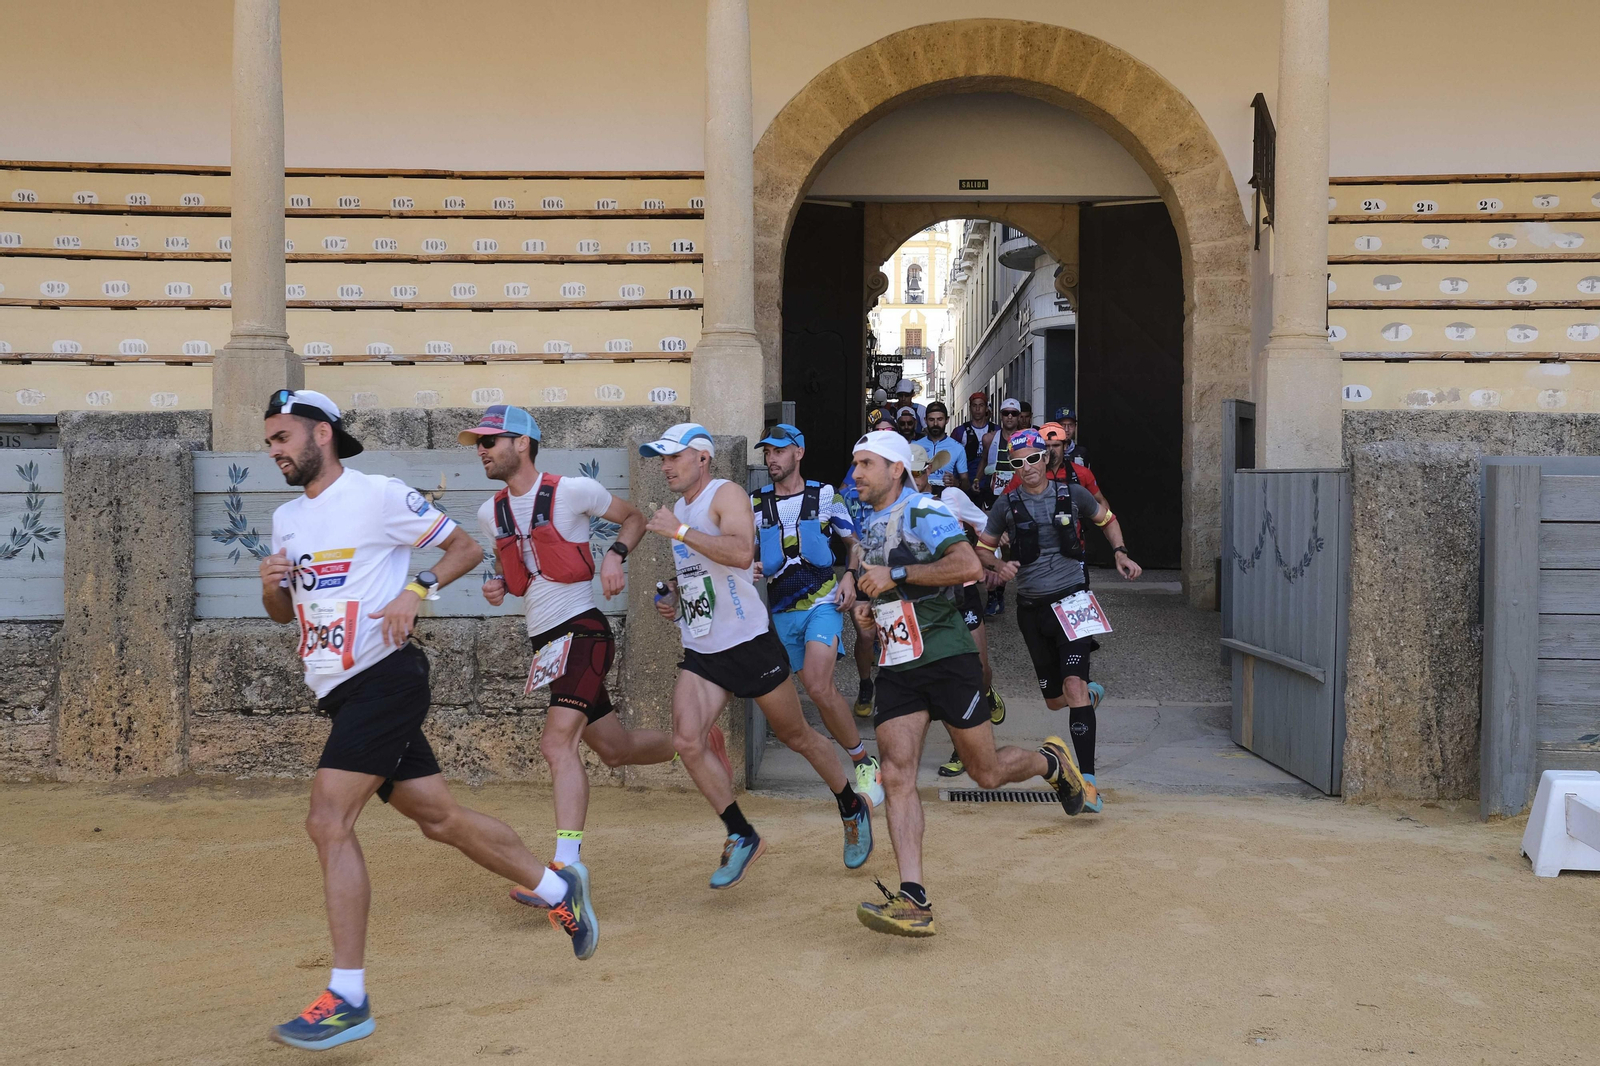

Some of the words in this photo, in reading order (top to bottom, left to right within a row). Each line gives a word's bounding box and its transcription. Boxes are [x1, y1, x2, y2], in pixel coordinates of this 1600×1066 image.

[961, 181, 986, 189] SALIDA
[17, 192, 35, 202] 96
[78, 194, 94, 204] 97
[130, 195, 147, 205] 98
[183, 196, 201, 206] 99
[291, 197, 311, 207] 101
[339, 198, 360, 208] 102
[444, 199, 466, 209] 104
[494, 199, 514, 209] 105
[542, 199, 563, 209] 106
[596, 200, 617, 210] 107
[644, 200, 665, 210] 108
[690, 199, 703, 209] 10
[56, 236, 80, 247] 102
[165, 237, 190, 248] 104
[219, 238, 232, 250] 10
[323, 238, 346, 250] 107
[374, 240, 397, 250] 108
[425, 240, 447, 251] 109
[476, 240, 497, 251] 110
[525, 241, 545, 252] 111
[579, 242, 600, 252] 112
[672, 242, 693, 252] 114
[46, 283, 66, 293] 99
[105, 281, 131, 293] 100
[168, 284, 192, 295] 101
[339, 287, 363, 297] 104
[393, 286, 416, 297] 105
[452, 285, 476, 297] 106
[506, 285, 529, 296] 107
[562, 285, 585, 296] 108
[622, 286, 645, 297] 109
[669, 288, 692, 299] 110
[1330, 329, 1338, 338] A
[122, 342, 148, 353] 100
[186, 342, 210, 353] 101
[491, 343, 516, 353] 106
[547, 342, 571, 353] 107
[608, 340, 632, 351] 108
[660, 339, 686, 351] 109
[877, 355, 901, 363] HOTEL
[89, 392, 111, 406] 96
[651, 389, 677, 402] 105
[321, 564, 345, 574] ACTIVE
[320, 577, 342, 587] SPORT
[1067, 606, 1100, 626] 3623
